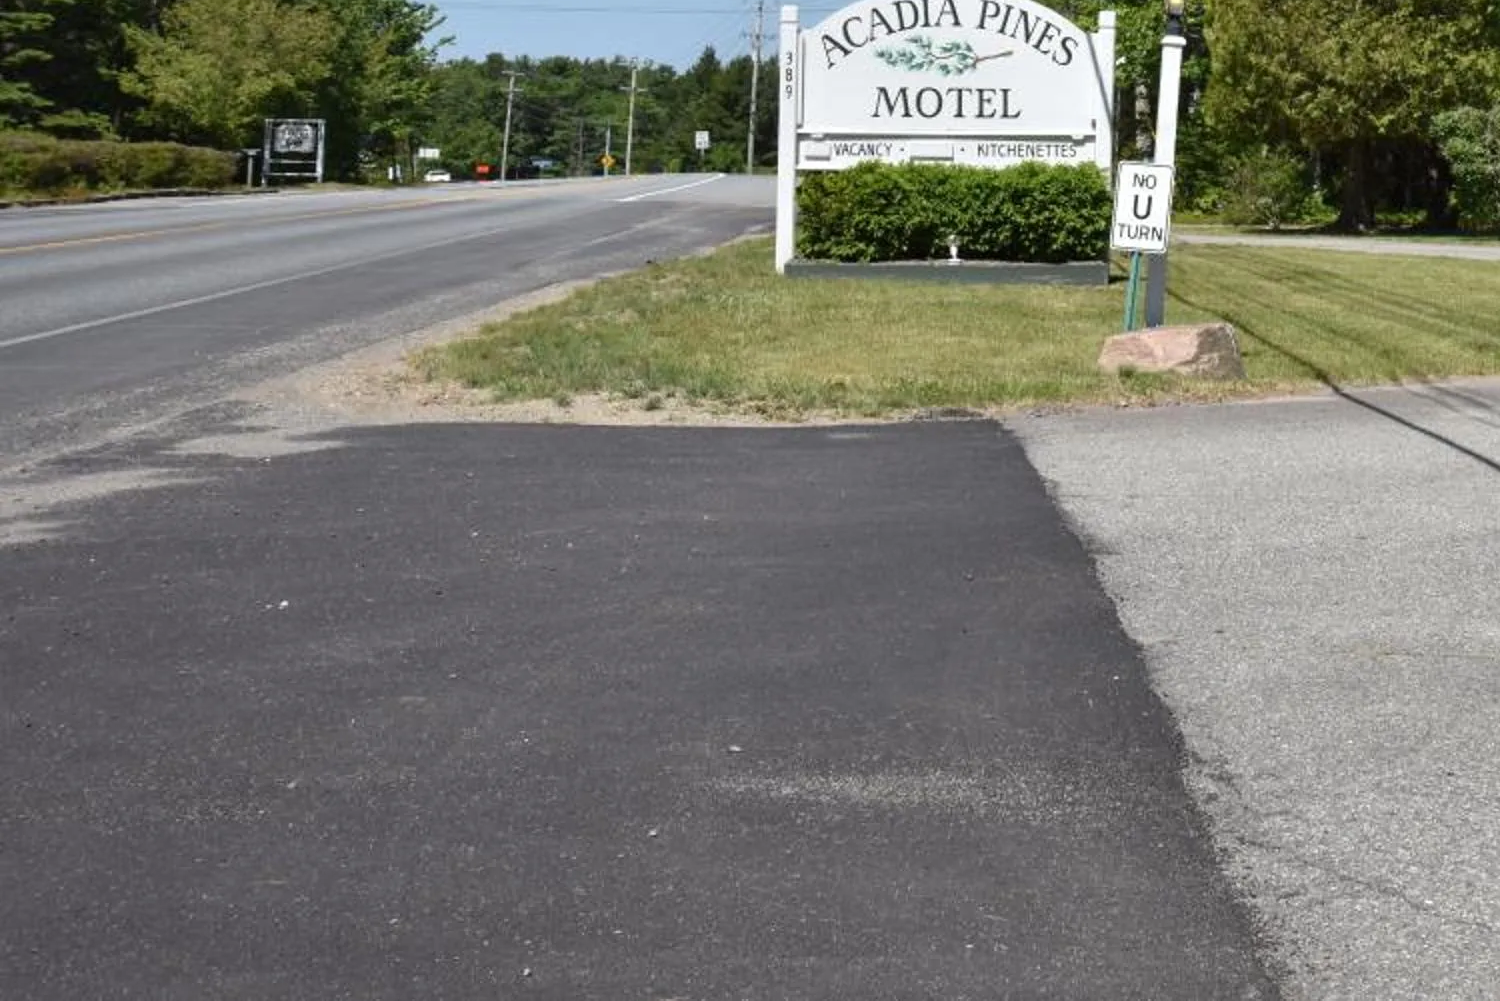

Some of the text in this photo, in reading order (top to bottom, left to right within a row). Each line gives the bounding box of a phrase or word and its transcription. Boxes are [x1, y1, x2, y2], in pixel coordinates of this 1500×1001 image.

[785, 50, 793, 99] 389
[871, 86, 1022, 119] MOTEL
[833, 142, 1078, 158] VACANCY KITCHENETTES
[1131, 172, 1158, 190] NO
[1132, 194, 1153, 220] U
[1117, 222, 1163, 242] TURN
